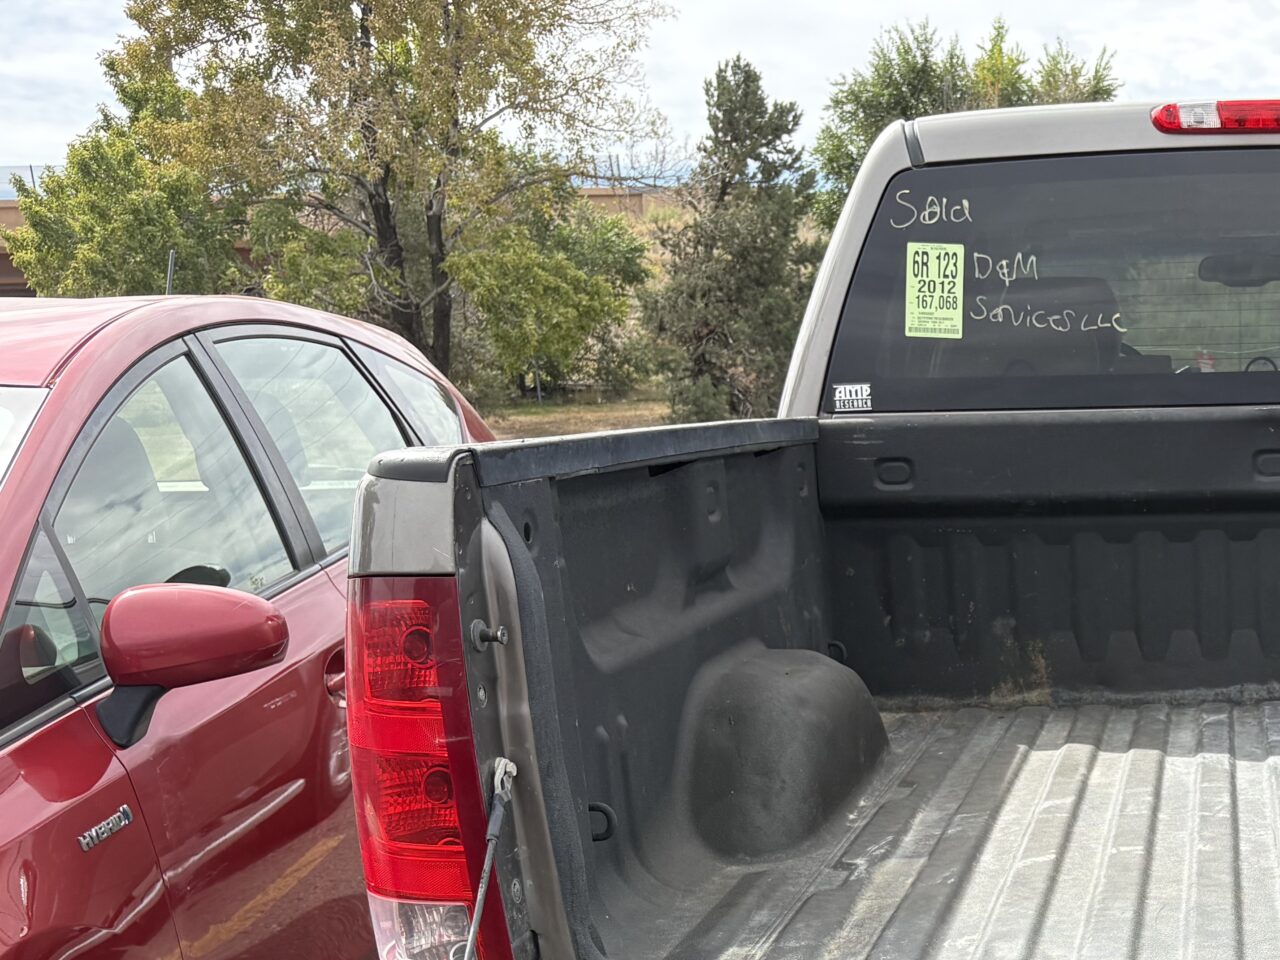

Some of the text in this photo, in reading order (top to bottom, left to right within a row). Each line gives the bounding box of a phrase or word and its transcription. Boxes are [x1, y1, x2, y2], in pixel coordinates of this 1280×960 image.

[912, 250, 958, 279] 6R 123
[917, 279, 956, 294] 2012
[915, 294, 958, 312] 167,068
[834, 384, 872, 400] AMP
[835, 399, 872, 409] RESEARCH
[77, 809, 130, 851] HYBRID
